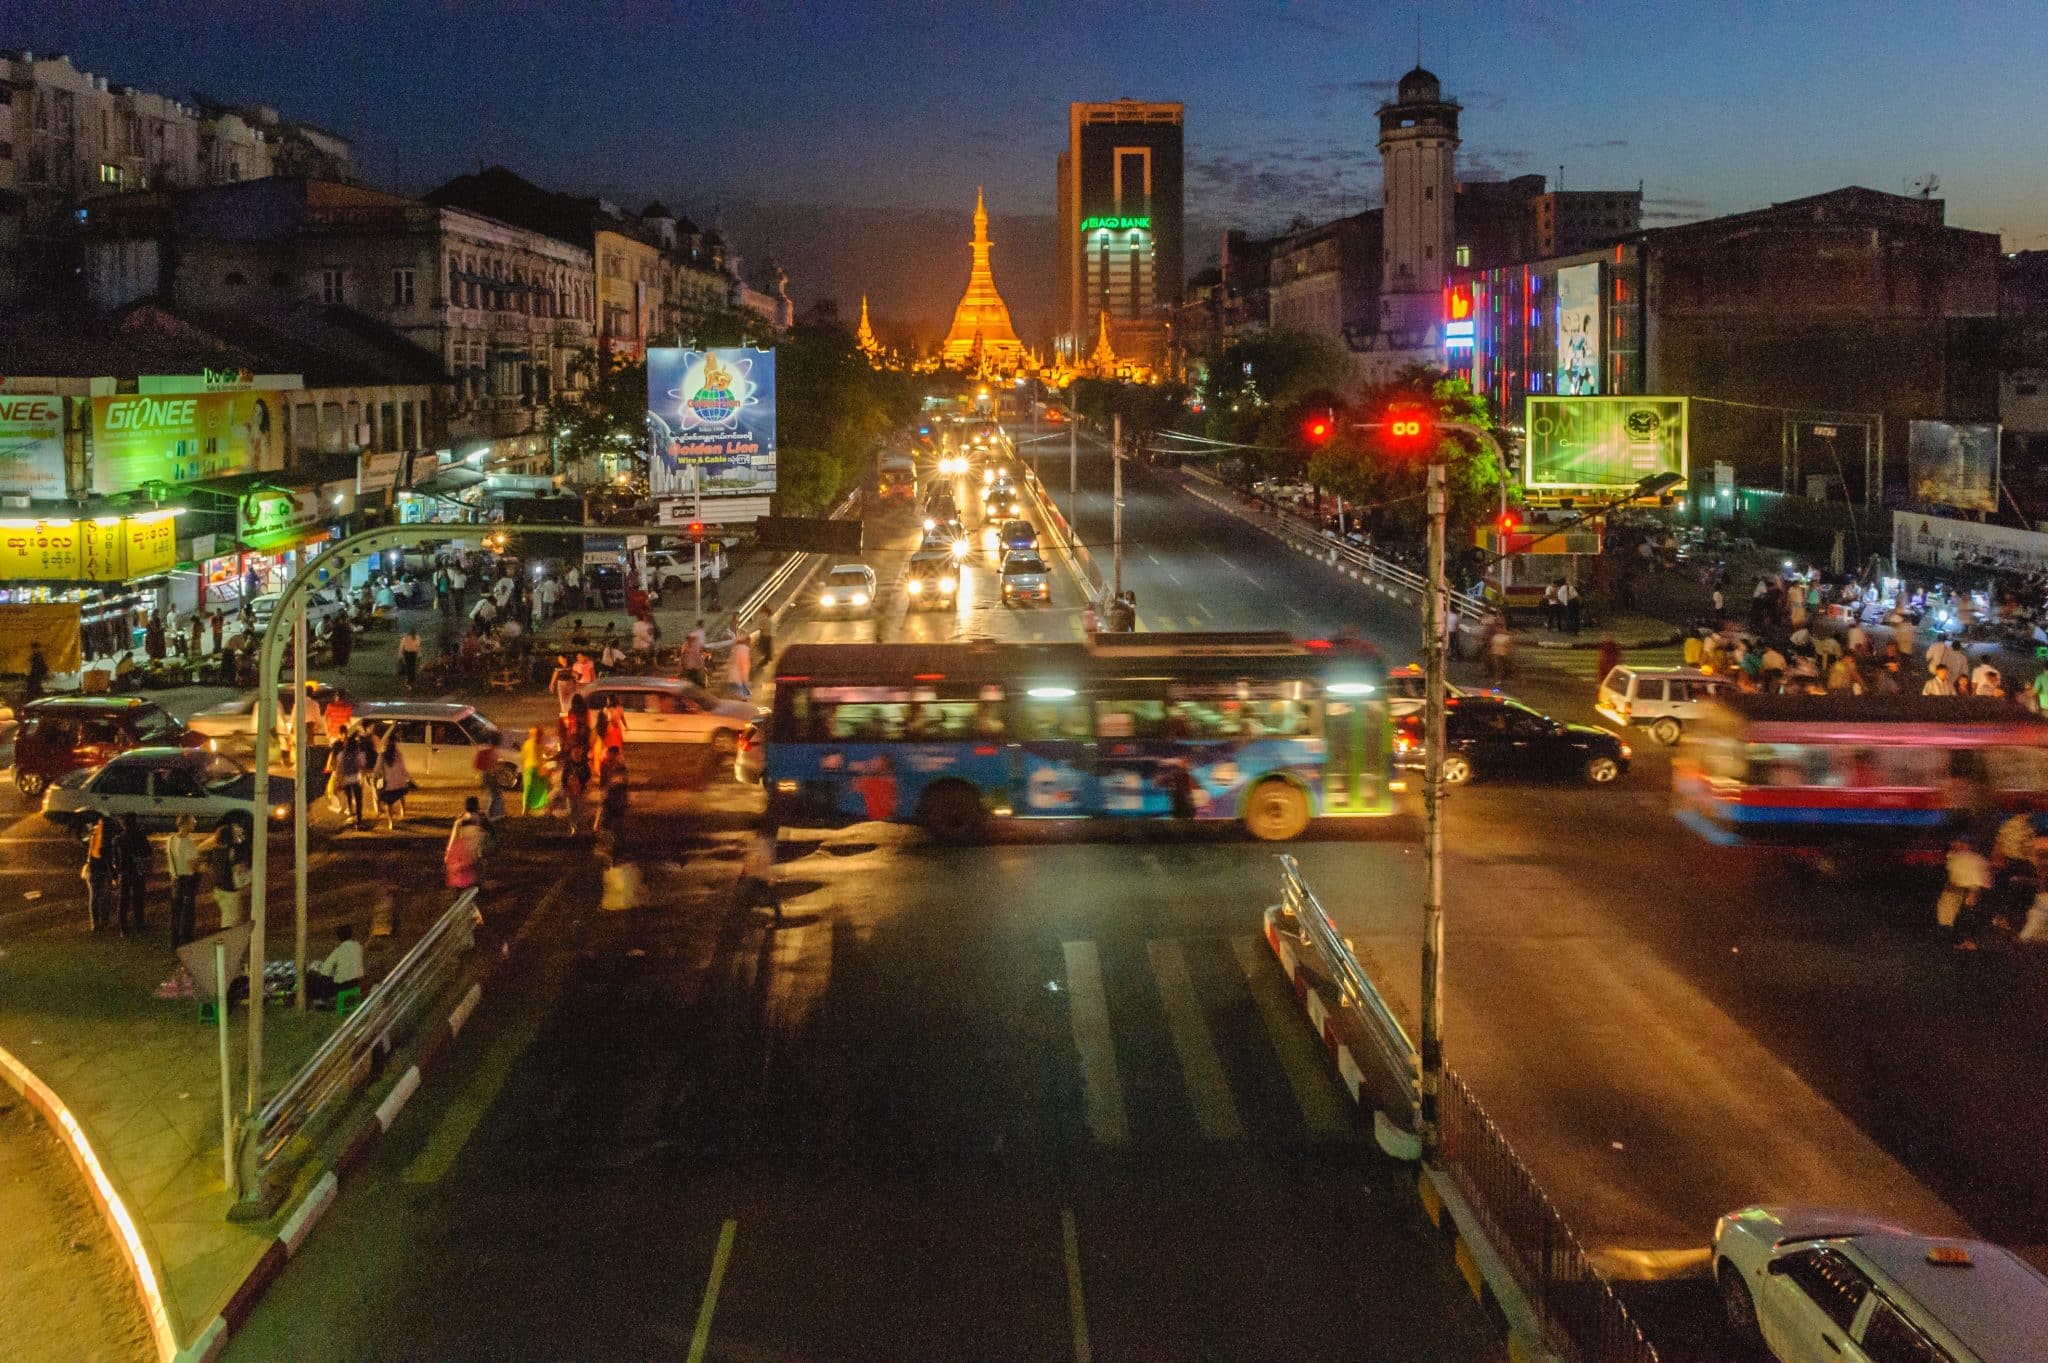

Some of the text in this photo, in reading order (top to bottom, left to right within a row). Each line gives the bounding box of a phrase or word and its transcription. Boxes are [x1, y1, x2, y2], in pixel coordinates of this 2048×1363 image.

[1121, 217, 1150, 229] BANK
[726, 441, 759, 454] Lion
[678, 456, 697, 464] Wire
